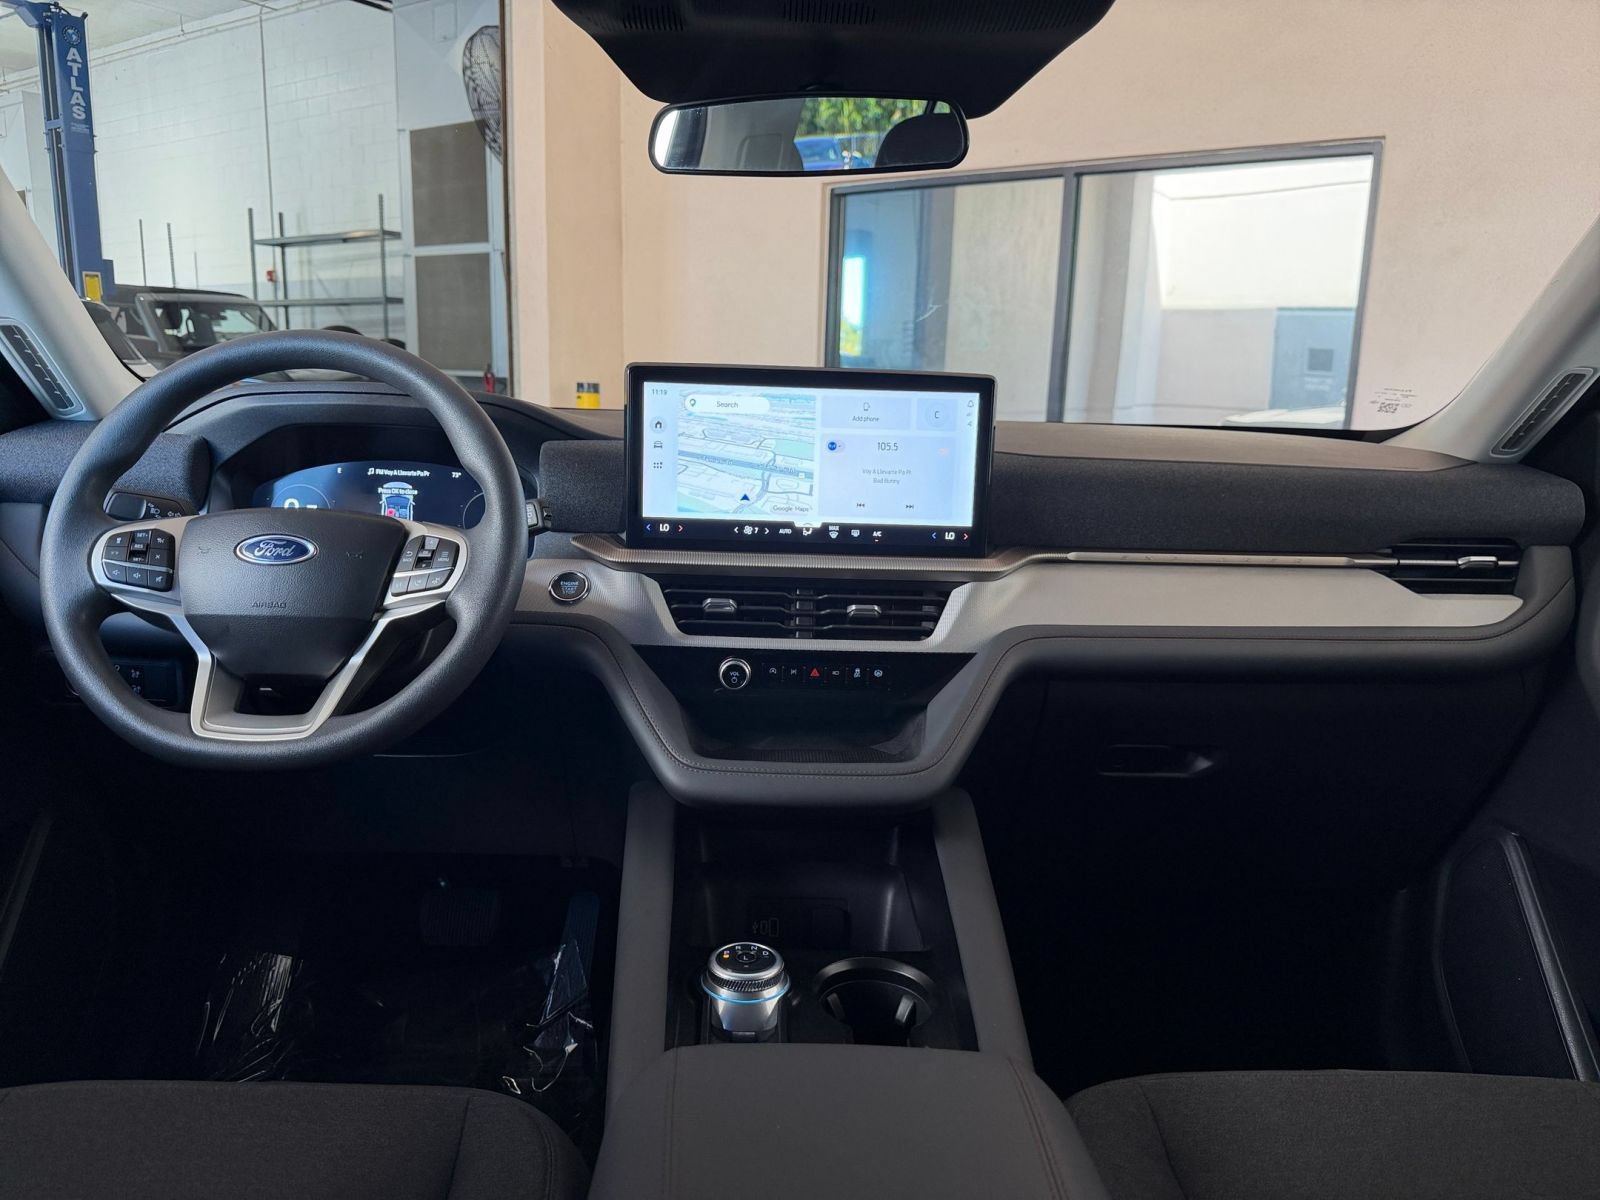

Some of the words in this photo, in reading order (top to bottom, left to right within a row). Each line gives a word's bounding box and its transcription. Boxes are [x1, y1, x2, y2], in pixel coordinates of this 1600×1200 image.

[66, 47, 86, 119] ATLAS
[877, 441, 899, 451] 105.5
[772, 504, 792, 512] Google
[659, 523, 670, 532] LO
[944, 531, 955, 540] LO
[254, 540, 296, 557] Ford
[251, 601, 287, 609] AIRBAG
